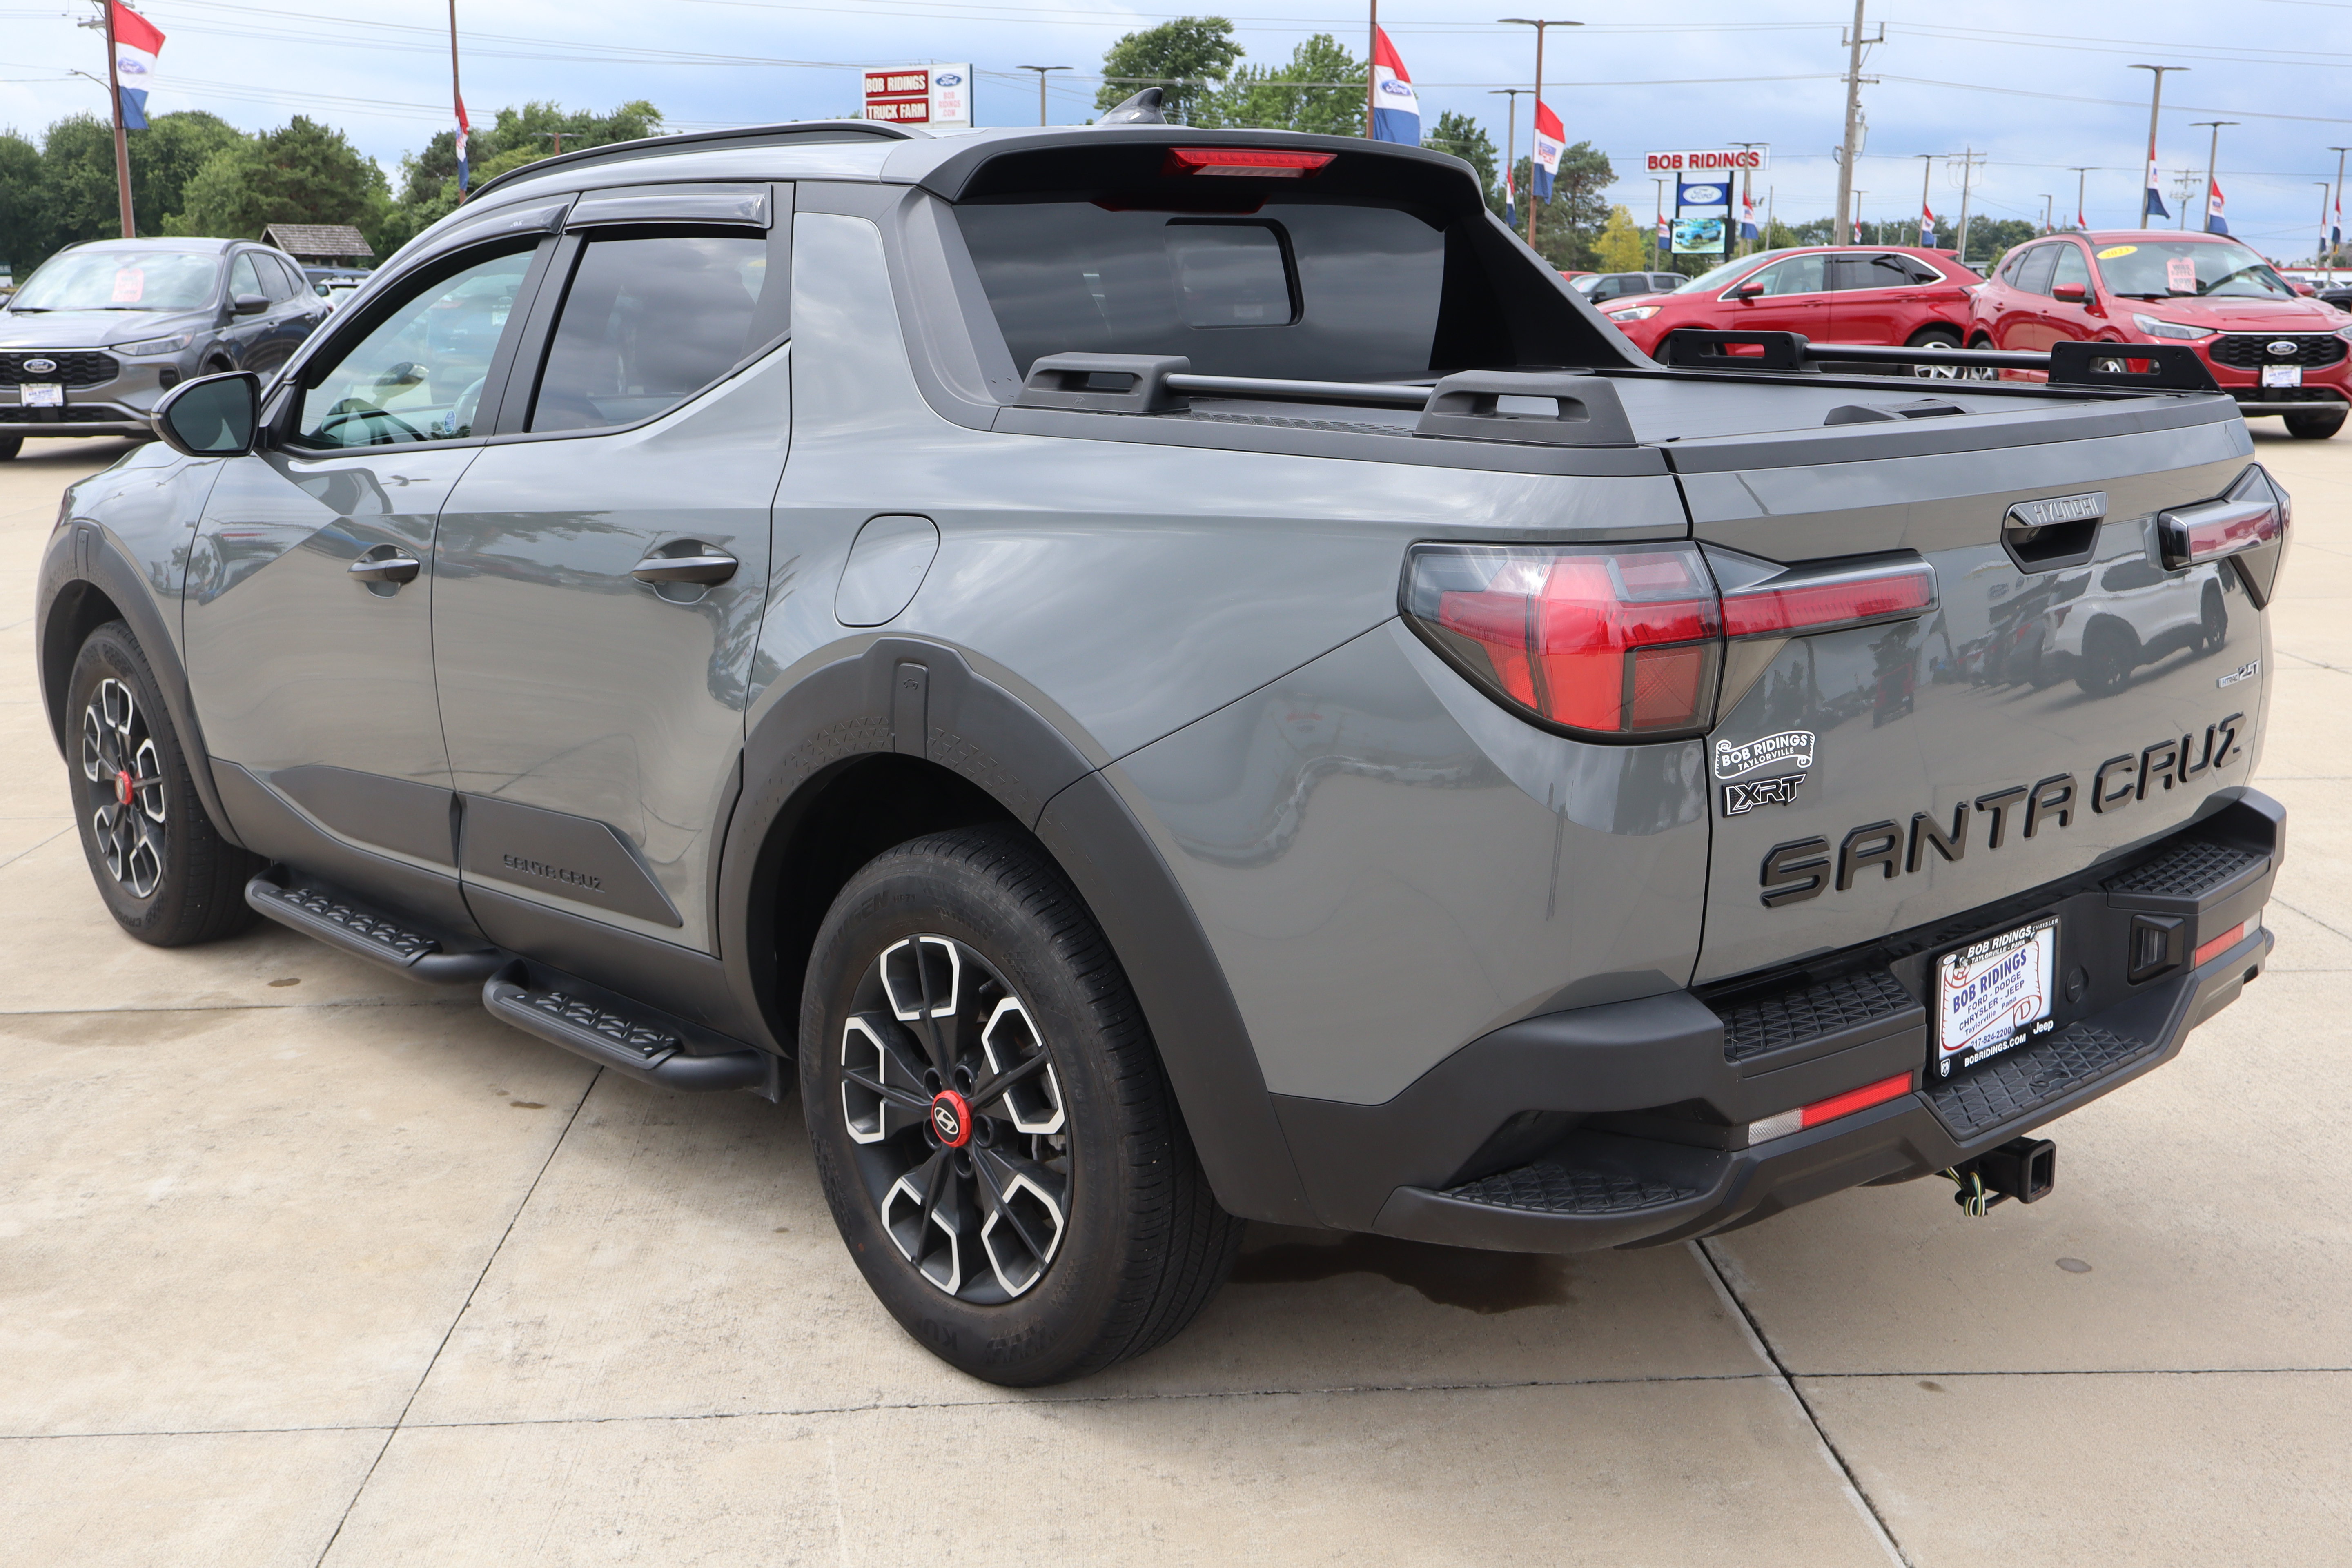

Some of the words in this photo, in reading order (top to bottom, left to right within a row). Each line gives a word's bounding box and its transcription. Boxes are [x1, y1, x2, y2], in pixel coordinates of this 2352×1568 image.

[866, 77, 885, 93] BOB
[887, 75, 926, 92] RIDINGS
[939, 75, 958, 85] Ford
[1385, 82, 1408, 95] Ford
[938, 100, 961, 108] RIDINGS
[943, 91, 955, 99] BOB
[867, 104, 899, 120] TRUCK
[900, 103, 927, 119] FARM
[1648, 154, 1682, 169] BOB
[1689, 152, 1760, 168] RIDINGS
[1690, 187, 1714, 200] Ford
[2032, 497, 2100, 523] HYUNDAI
[2222, 674, 2238, 686] HTRAC
[1722, 748, 1751, 767] BOB
[1753, 734, 1808, 756] RIDINGS
[1738, 747, 1794, 771] TAYLORVILLE
[1760, 773, 2079, 909] SANTA
[2092, 711, 2247, 815] CRUZ
[503, 854, 556, 881] SANTA
[559, 868, 605, 893] CRUZ
[1967, 941, 1990, 958] BOB
[1991, 925, 2032, 950] RIDINGS
[2032, 918, 2058, 931] CHRYSLER
[1971, 946, 2007, 964] TAYLORVILLE
[2011, 939, 2025, 949] PANA
[1953, 983, 1976, 1014] BOB
[1980, 948, 2027, 994] RIDINGS
[1968, 993, 1988, 1014] FORD
[1995, 971, 2022, 994] DODGE
[1959, 997, 1998, 1031] CHRYSLER
[2005, 980, 2025, 998] JEEP
[1964, 1010, 1996, 1036] Taylorville
[2002, 996, 2017, 1010] Pana
[1964, 1033, 2027, 1067] BOBRIDINGS.COM
[2033, 1020, 2054, 1035] Jeep
[1971, 1026, 2011, 1047] 217-824-2200
